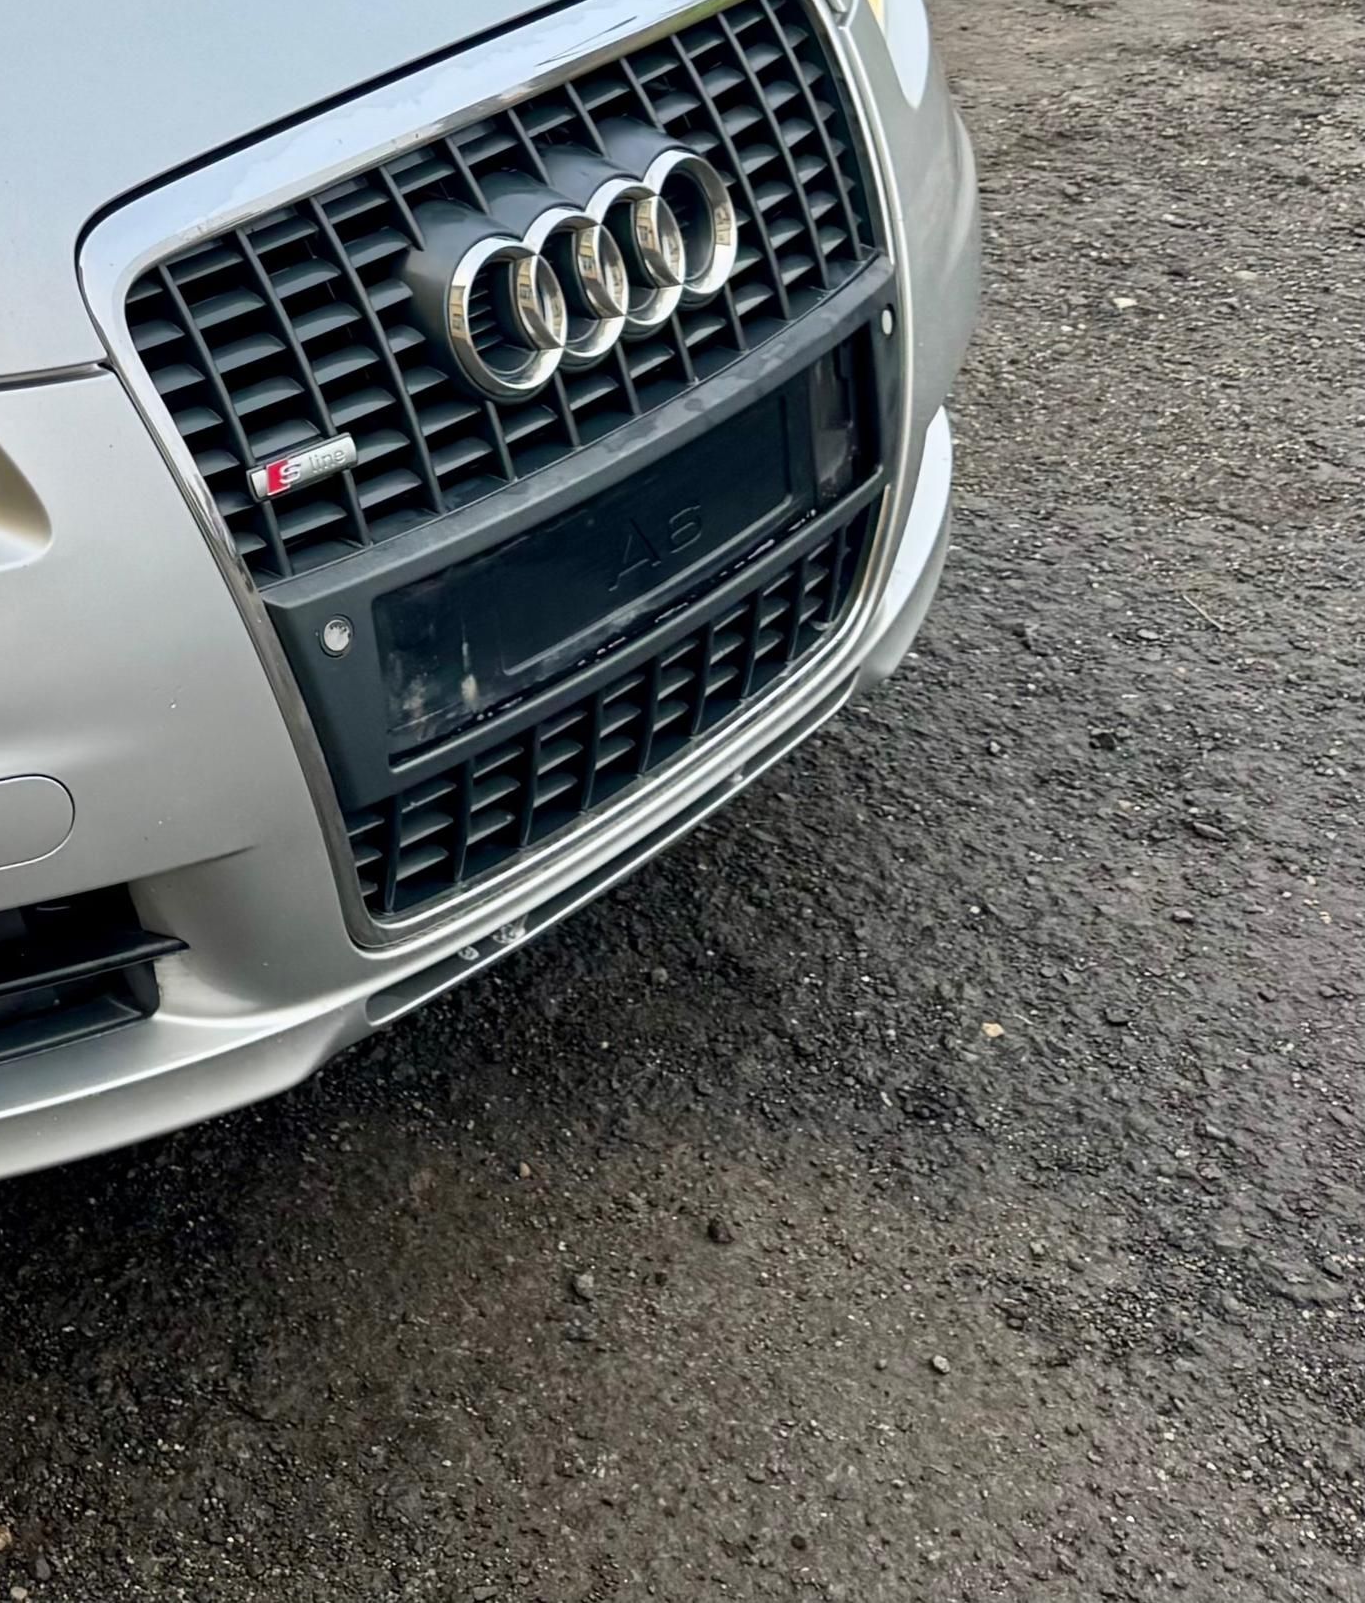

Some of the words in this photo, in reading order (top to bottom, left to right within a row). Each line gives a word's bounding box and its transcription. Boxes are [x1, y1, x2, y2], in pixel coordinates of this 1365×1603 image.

[279, 463, 301, 485] S
[309, 450, 346, 474] line
[609, 503, 702, 592] A6
